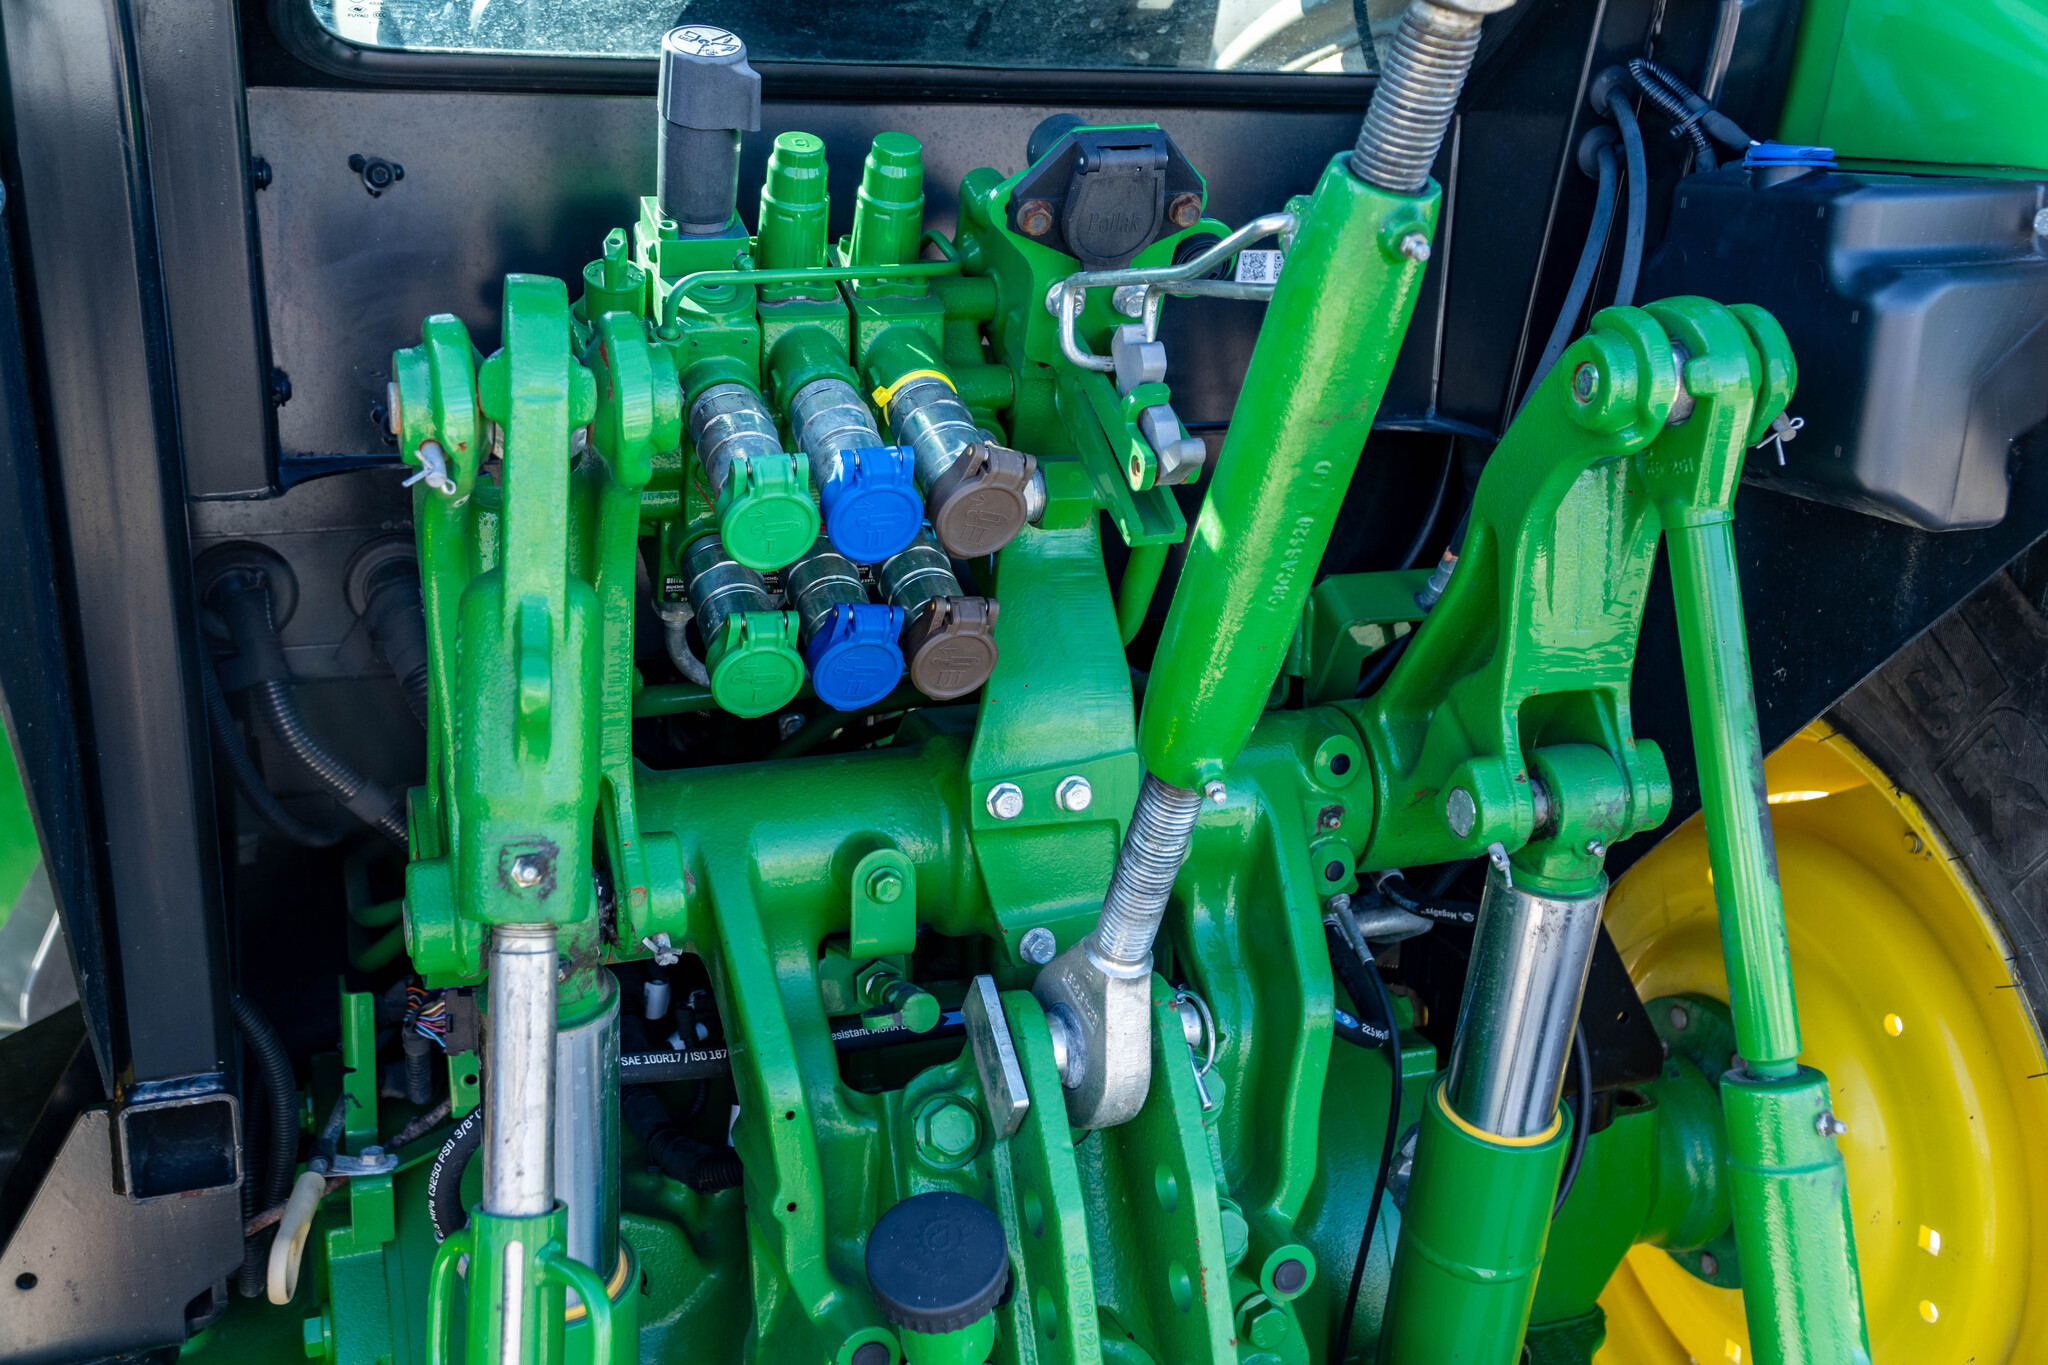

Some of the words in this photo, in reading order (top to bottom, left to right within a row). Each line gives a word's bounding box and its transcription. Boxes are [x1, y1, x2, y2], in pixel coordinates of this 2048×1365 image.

[1088, 210, 1140, 234] Pollak
[831, 1027, 870, 1041] esistant
[620, 1055, 642, 1067] SAE
[643, 1052, 682, 1065] 100R17
[690, 1051, 708, 1062] ISO
[428, 1162, 443, 1197] (3250
[437, 1138, 456, 1163] PSI)
[454, 1113, 475, 1140] 3/8"
